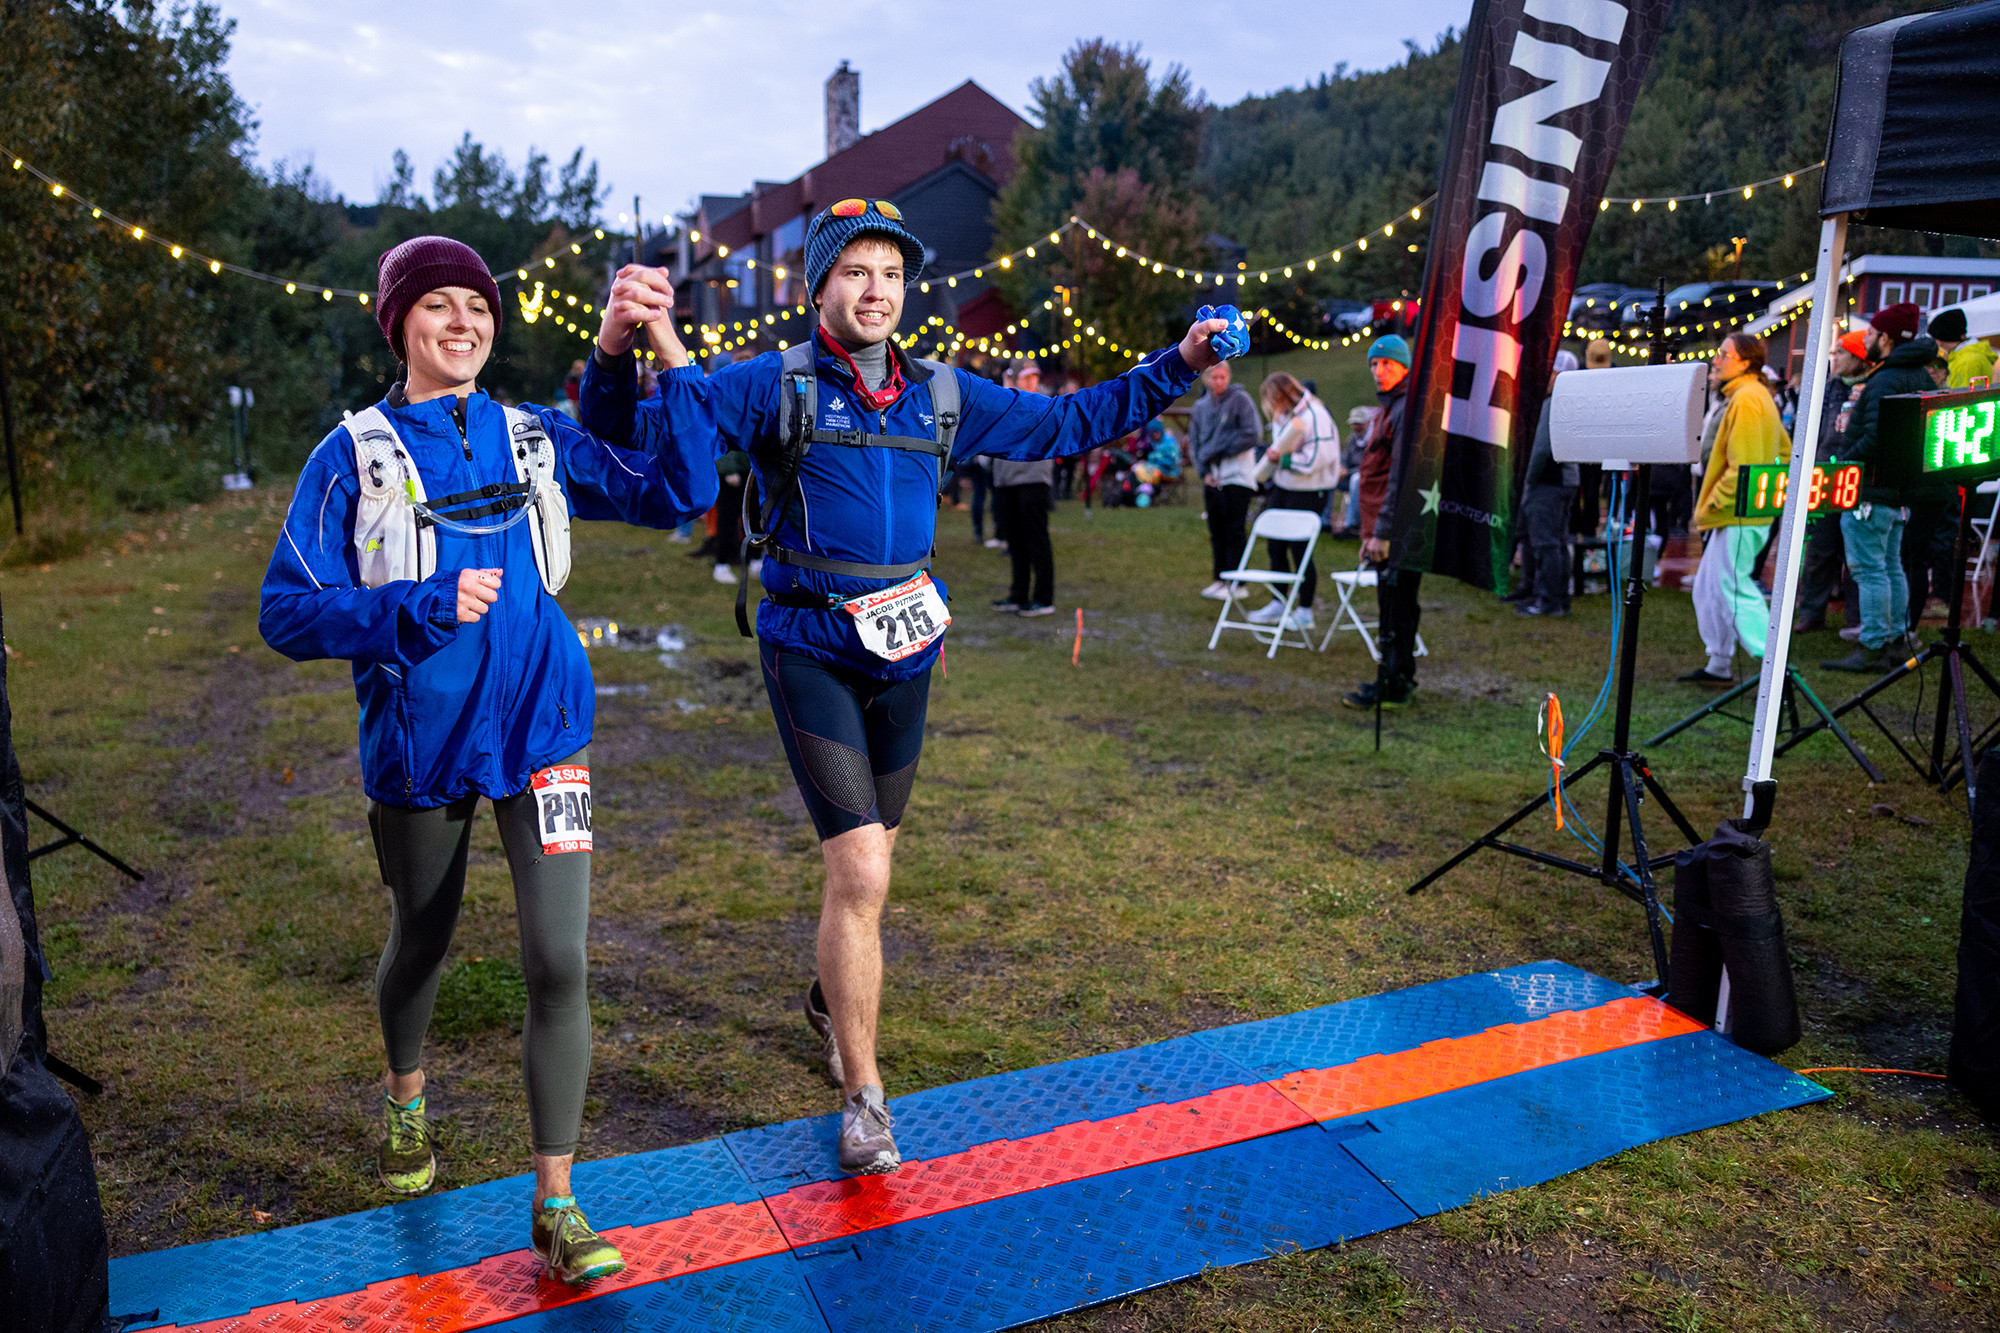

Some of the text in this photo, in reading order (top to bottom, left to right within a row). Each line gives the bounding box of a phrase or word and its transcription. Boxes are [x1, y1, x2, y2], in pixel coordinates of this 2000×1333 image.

[1934, 401, 2000, 467] 14:2
[865, 591, 925, 619] JACOB PITTMAN
[876, 601, 935, 650] 215
[542, 791, 592, 834] PAC
[558, 841, 578, 851] 100
